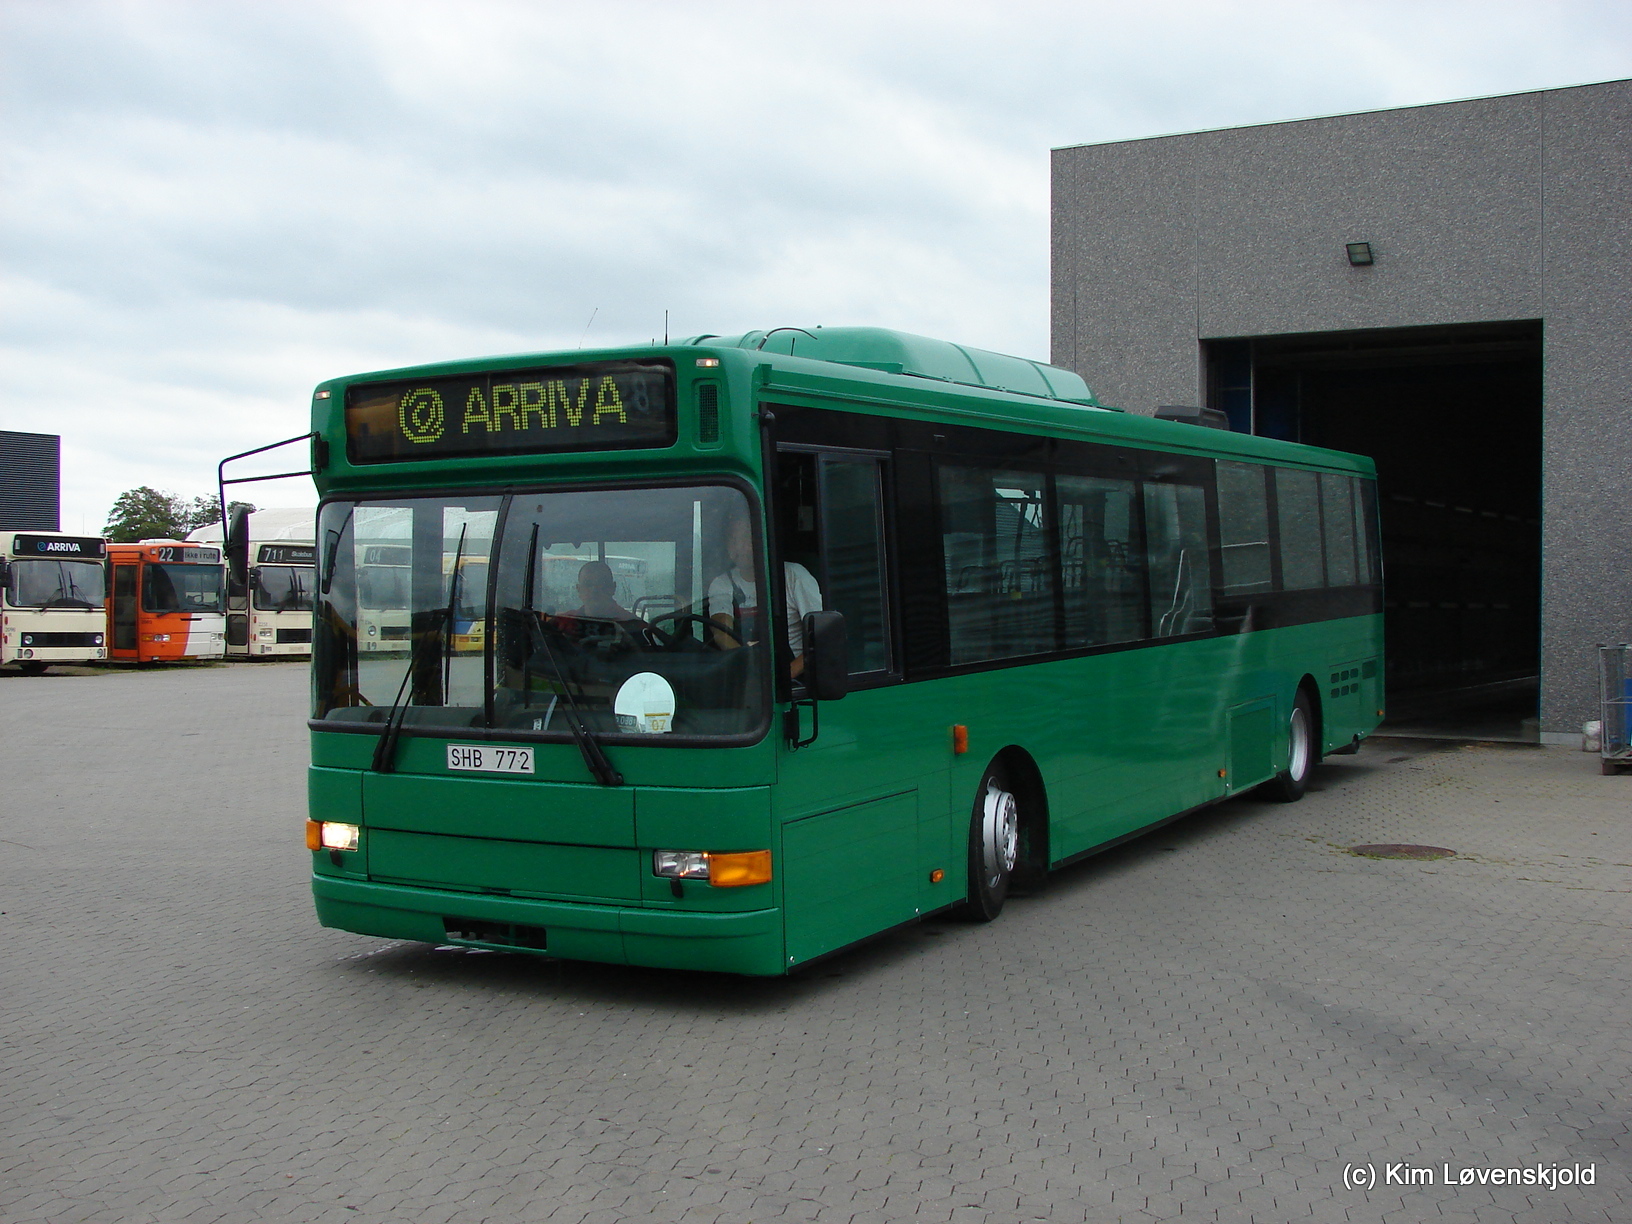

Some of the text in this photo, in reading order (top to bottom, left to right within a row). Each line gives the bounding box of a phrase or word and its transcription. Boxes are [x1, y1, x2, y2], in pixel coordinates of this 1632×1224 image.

[462, 375, 627, 434] ARRIVA
[46, 542, 81, 552] ARRIVA
[264, 547, 284, 561] 711
[159, 547, 174, 562] 22
[651, 719, 667, 731] 07
[451, 748, 530, 770] SHB 772
